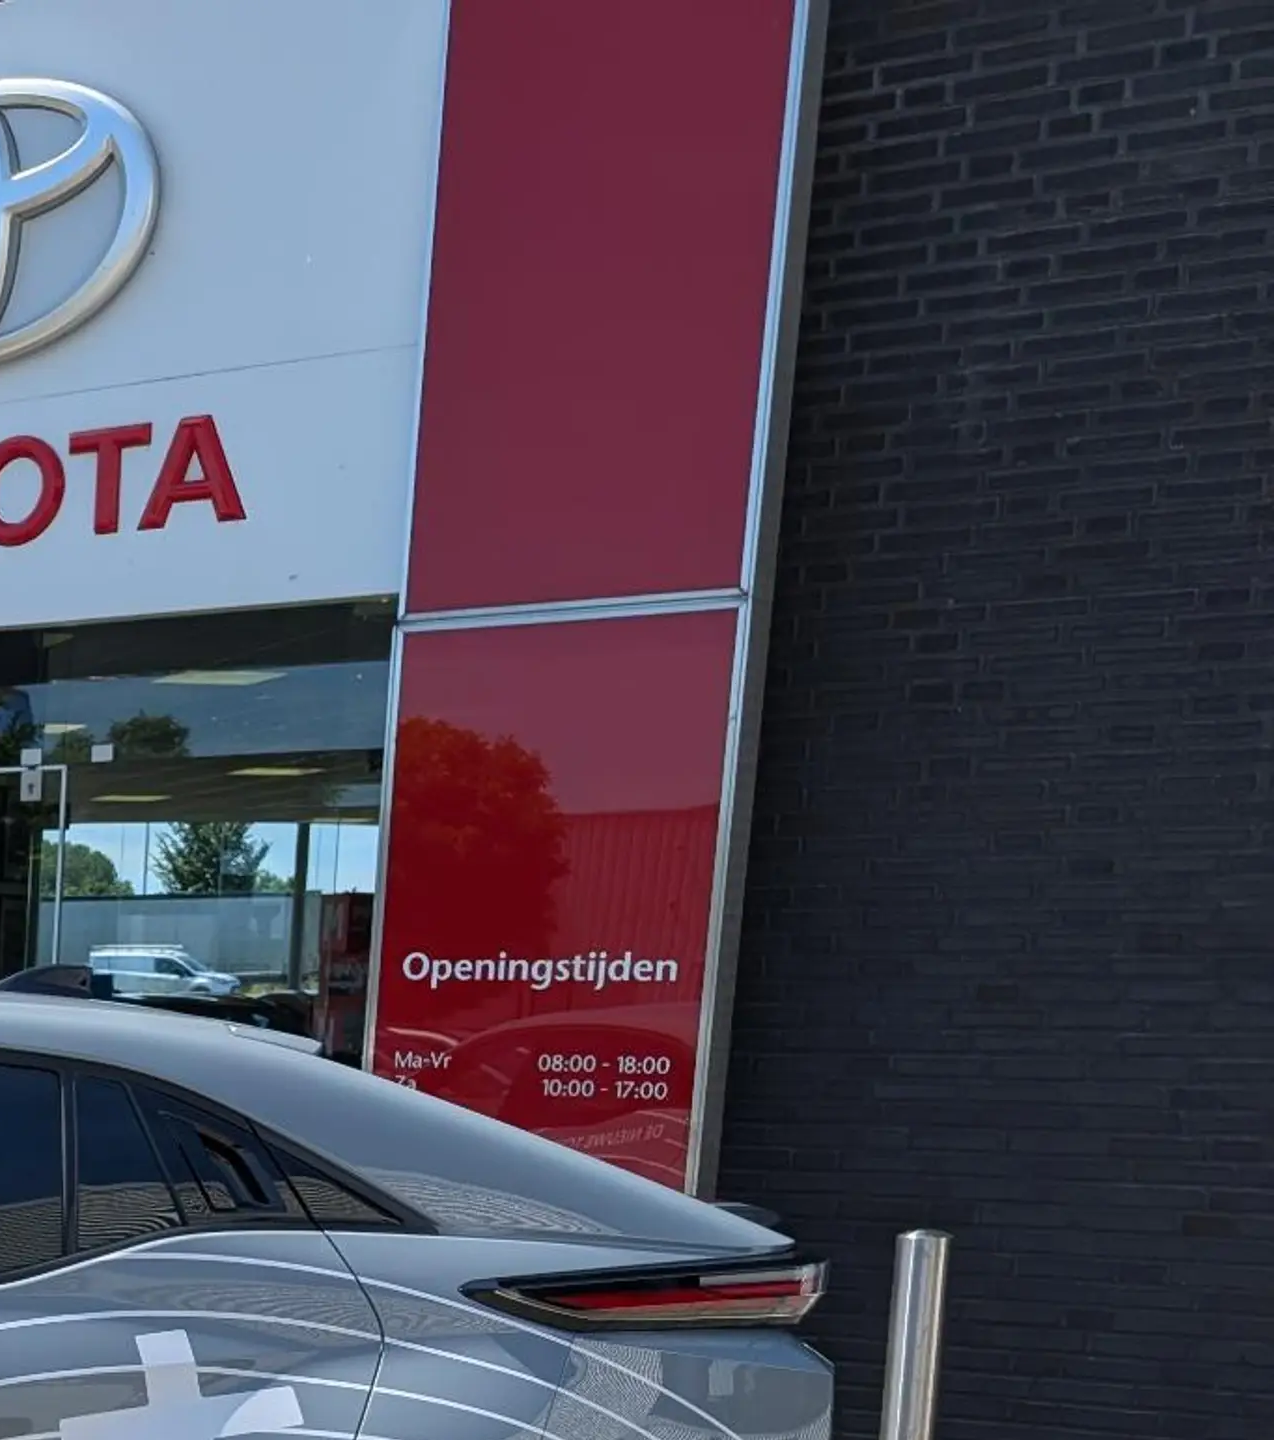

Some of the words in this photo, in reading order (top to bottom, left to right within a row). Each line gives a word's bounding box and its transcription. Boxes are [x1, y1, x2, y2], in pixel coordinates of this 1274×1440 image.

[402, 951, 678, 990] Openingstijden
[394, 1051, 452, 1070] Ma-Vr
[538, 1054, 596, 1073] 08:00
[617, 1056, 671, 1076] 18:00
[542, 1078, 594, 1098] 10:00
[615, 1080, 668, 1101] 17:00
